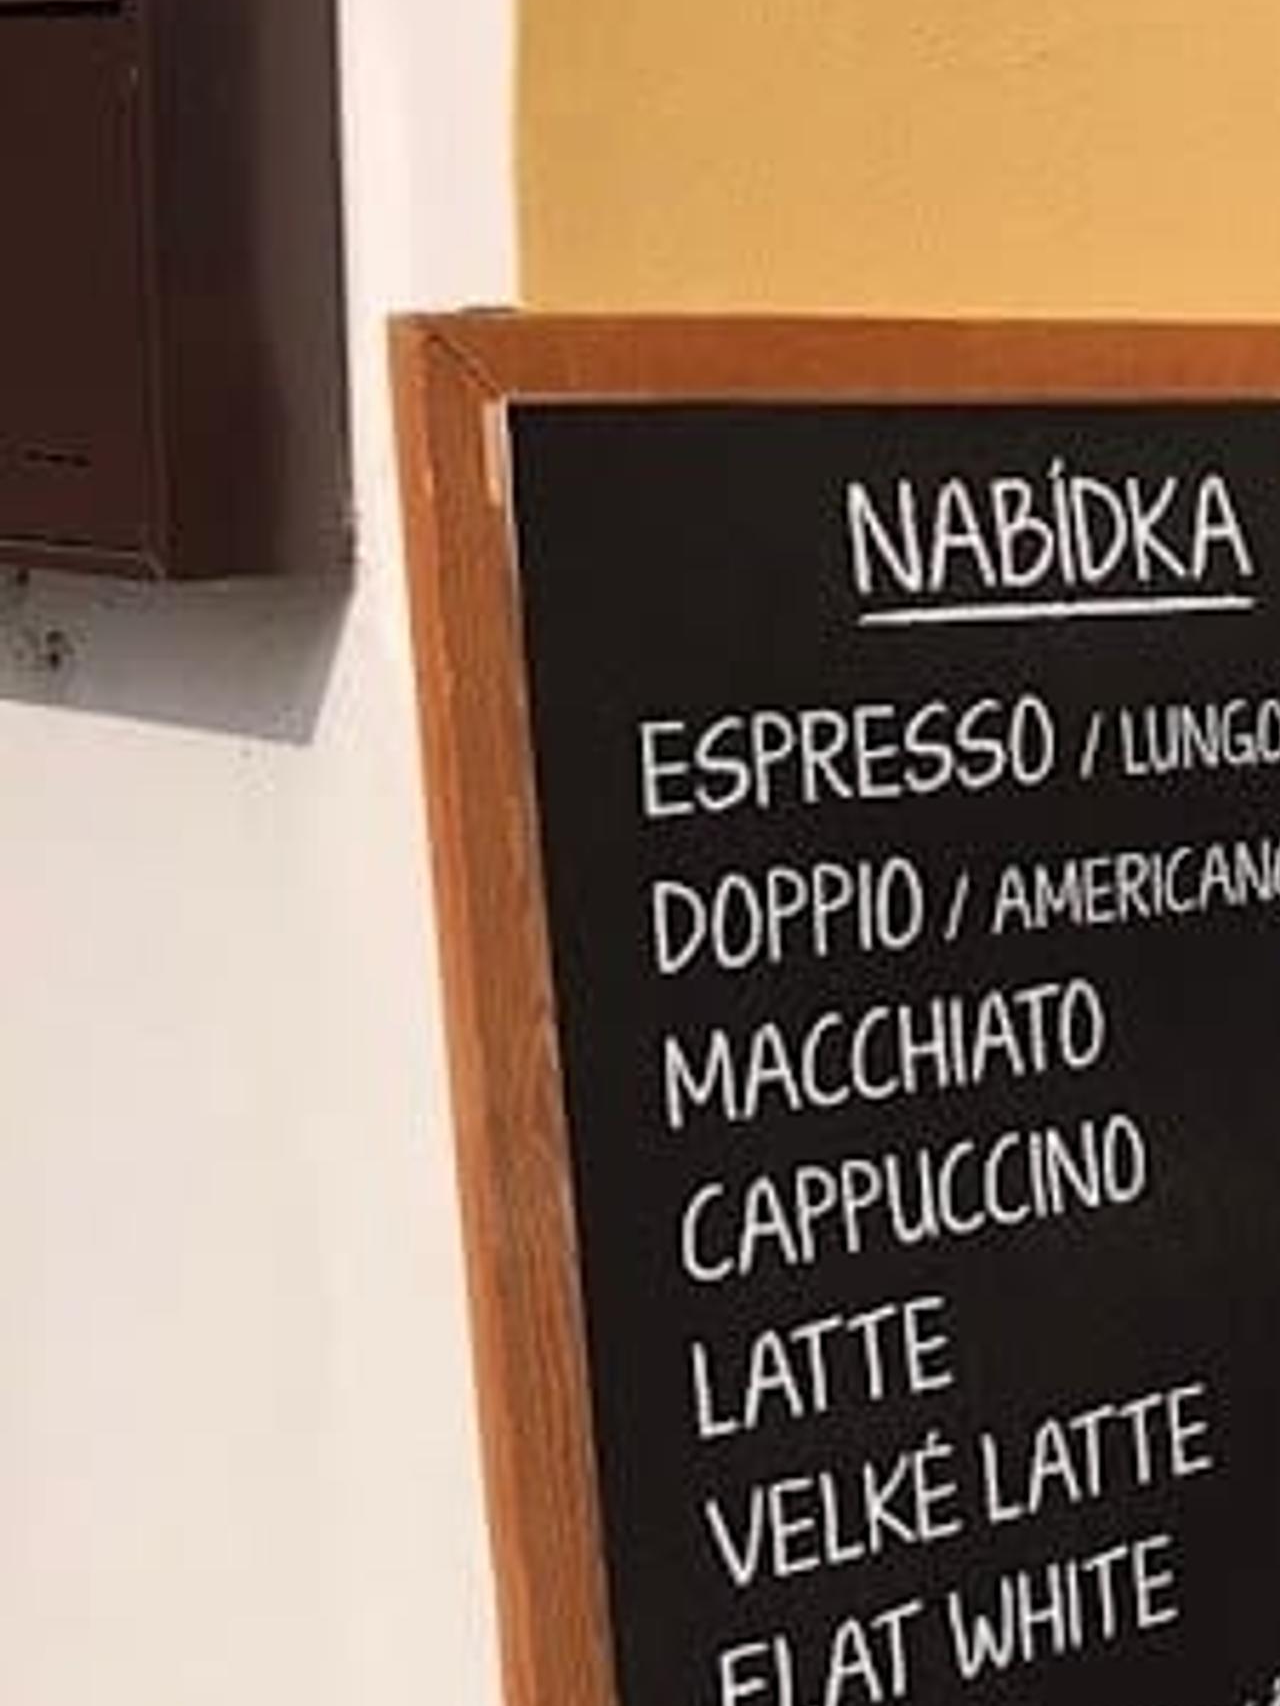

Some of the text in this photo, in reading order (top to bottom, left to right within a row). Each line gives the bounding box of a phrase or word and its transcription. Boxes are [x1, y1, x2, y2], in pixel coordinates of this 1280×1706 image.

[845, 458, 1255, 596] NABÍDKA
[638, 693, 1055, 819] ESPRESSO
[650, 855, 925, 975] DOPPIO
[662, 978, 1105, 1131] MACCHIATO
[680, 1113, 1146, 1283] CAPPUCCINO
[690, 1295, 955, 1438] LATTE
[705, 1385, 1214, 1586] VELKÉ LATTE
[948, 1535, 1178, 1681] WHITE
